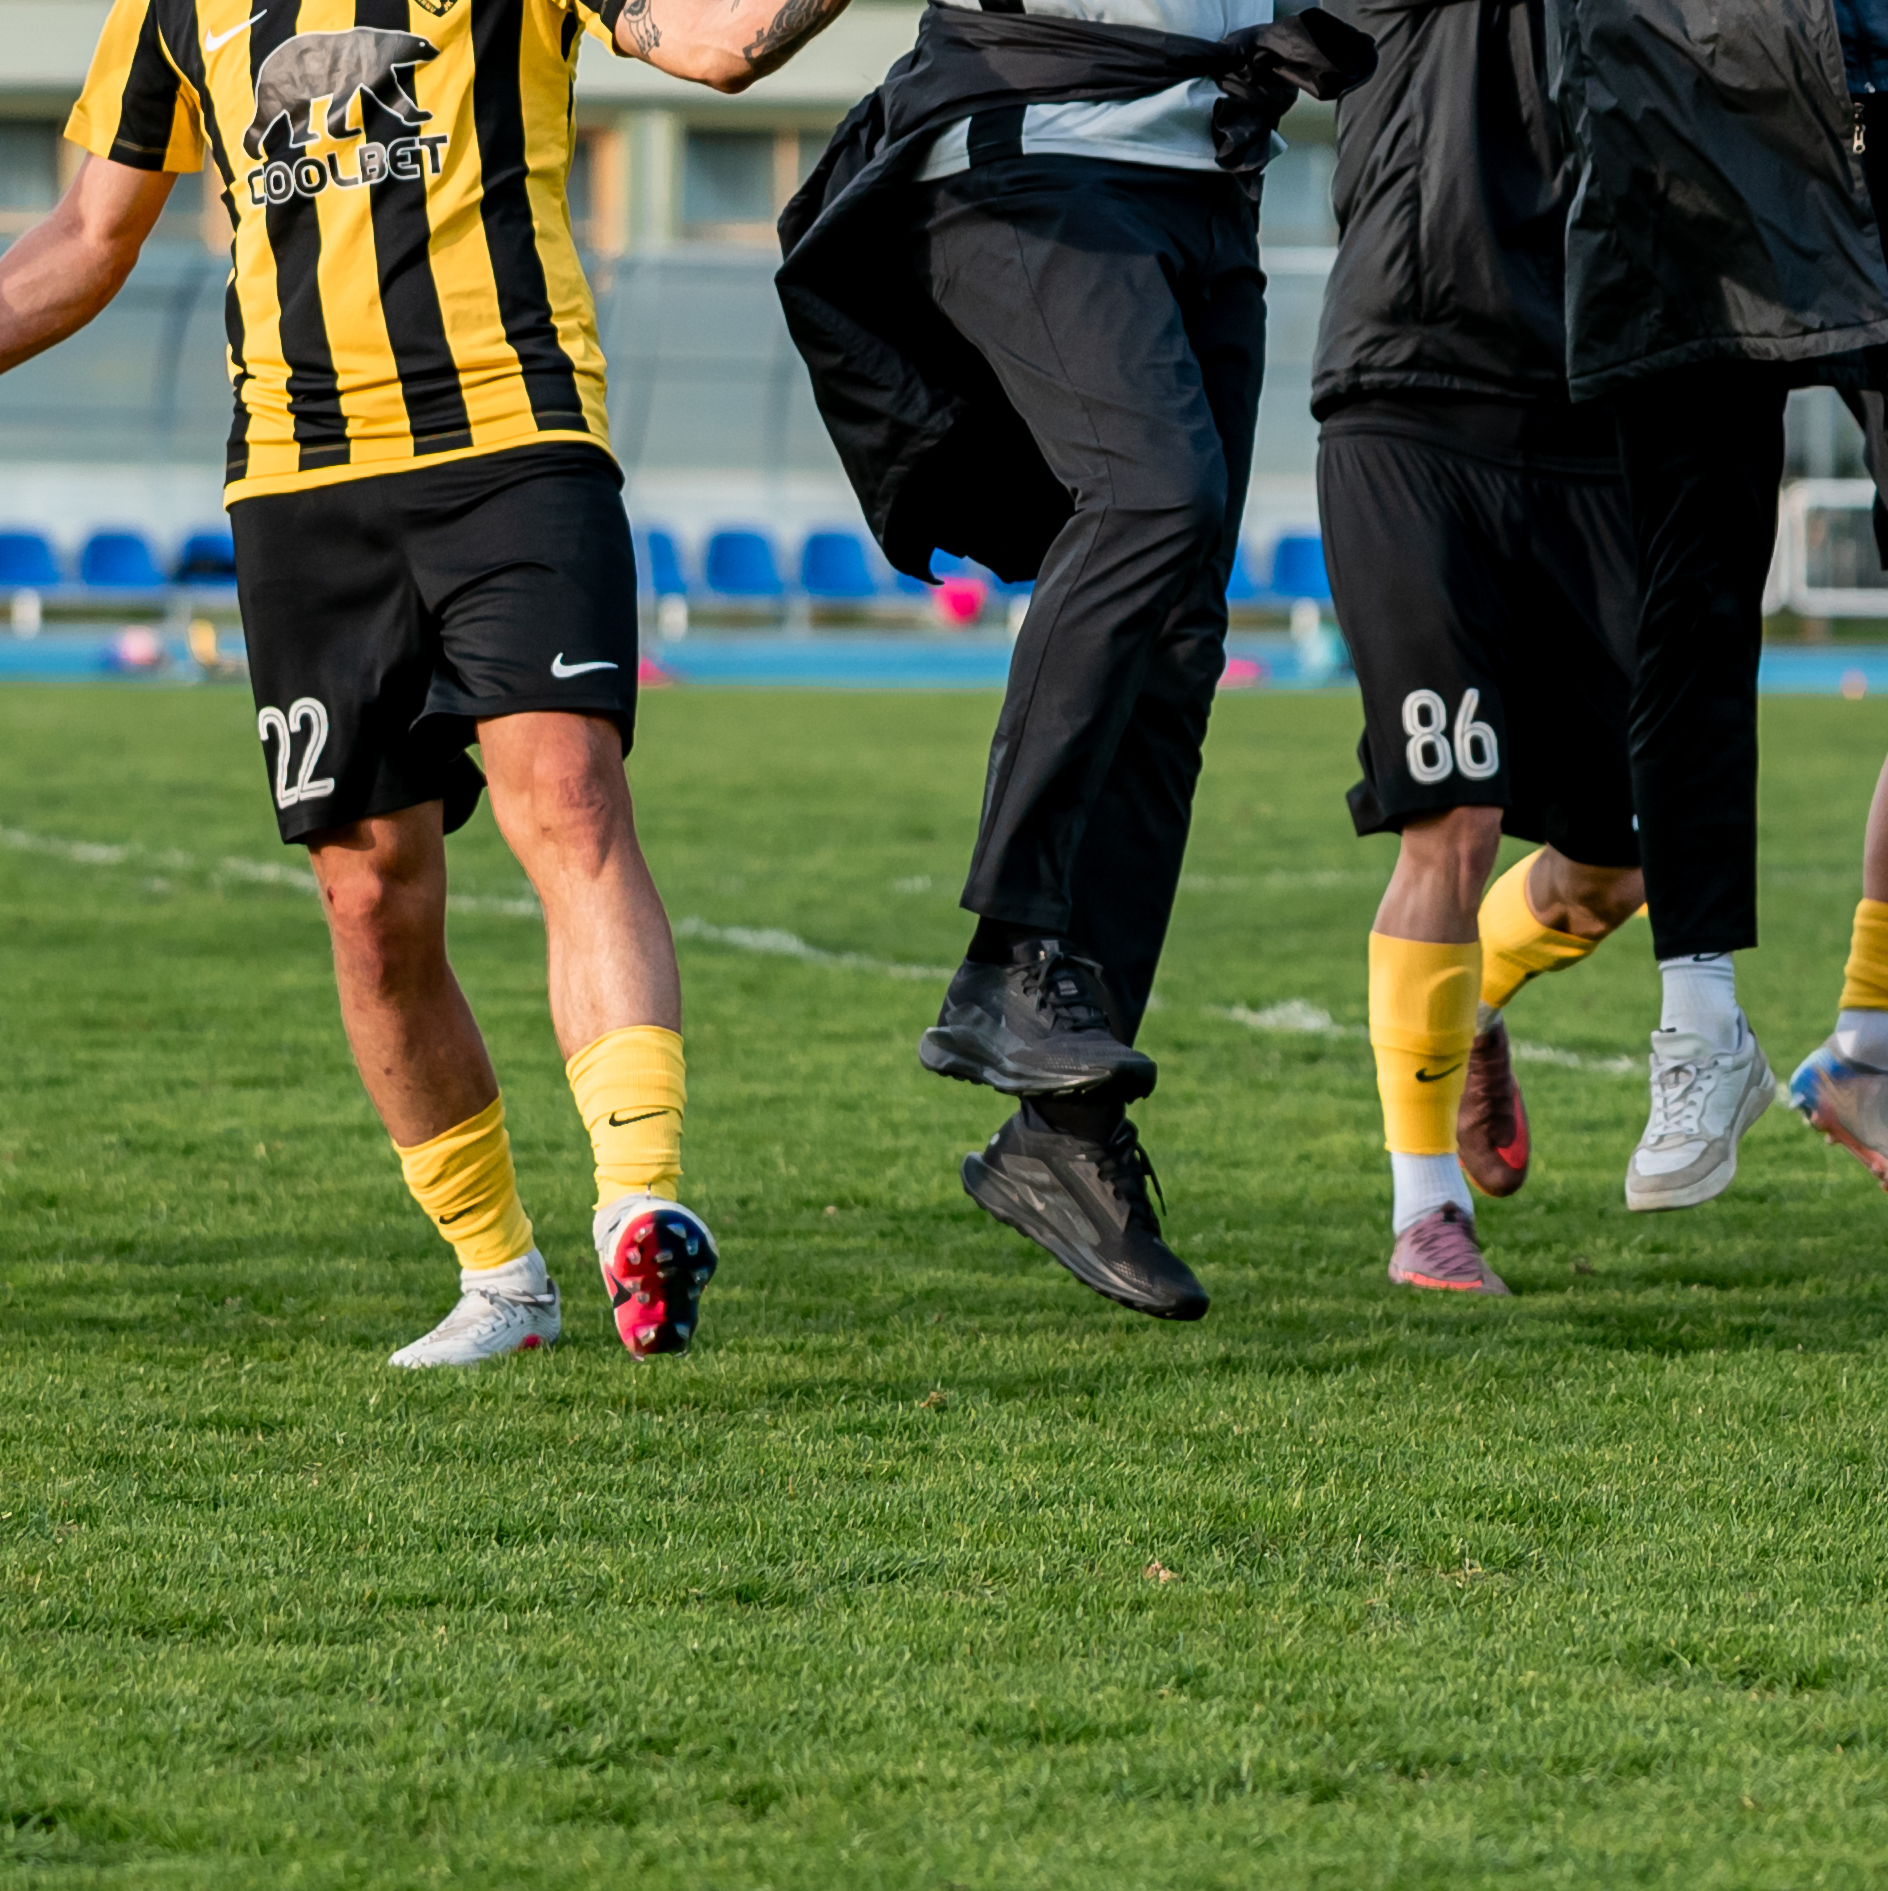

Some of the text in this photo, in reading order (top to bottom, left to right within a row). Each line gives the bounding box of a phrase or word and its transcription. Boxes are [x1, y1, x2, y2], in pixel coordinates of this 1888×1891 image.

[246, 134, 449, 207] COOLBET
[258, 696, 335, 809] 22
[1402, 687, 1500, 785] 86
